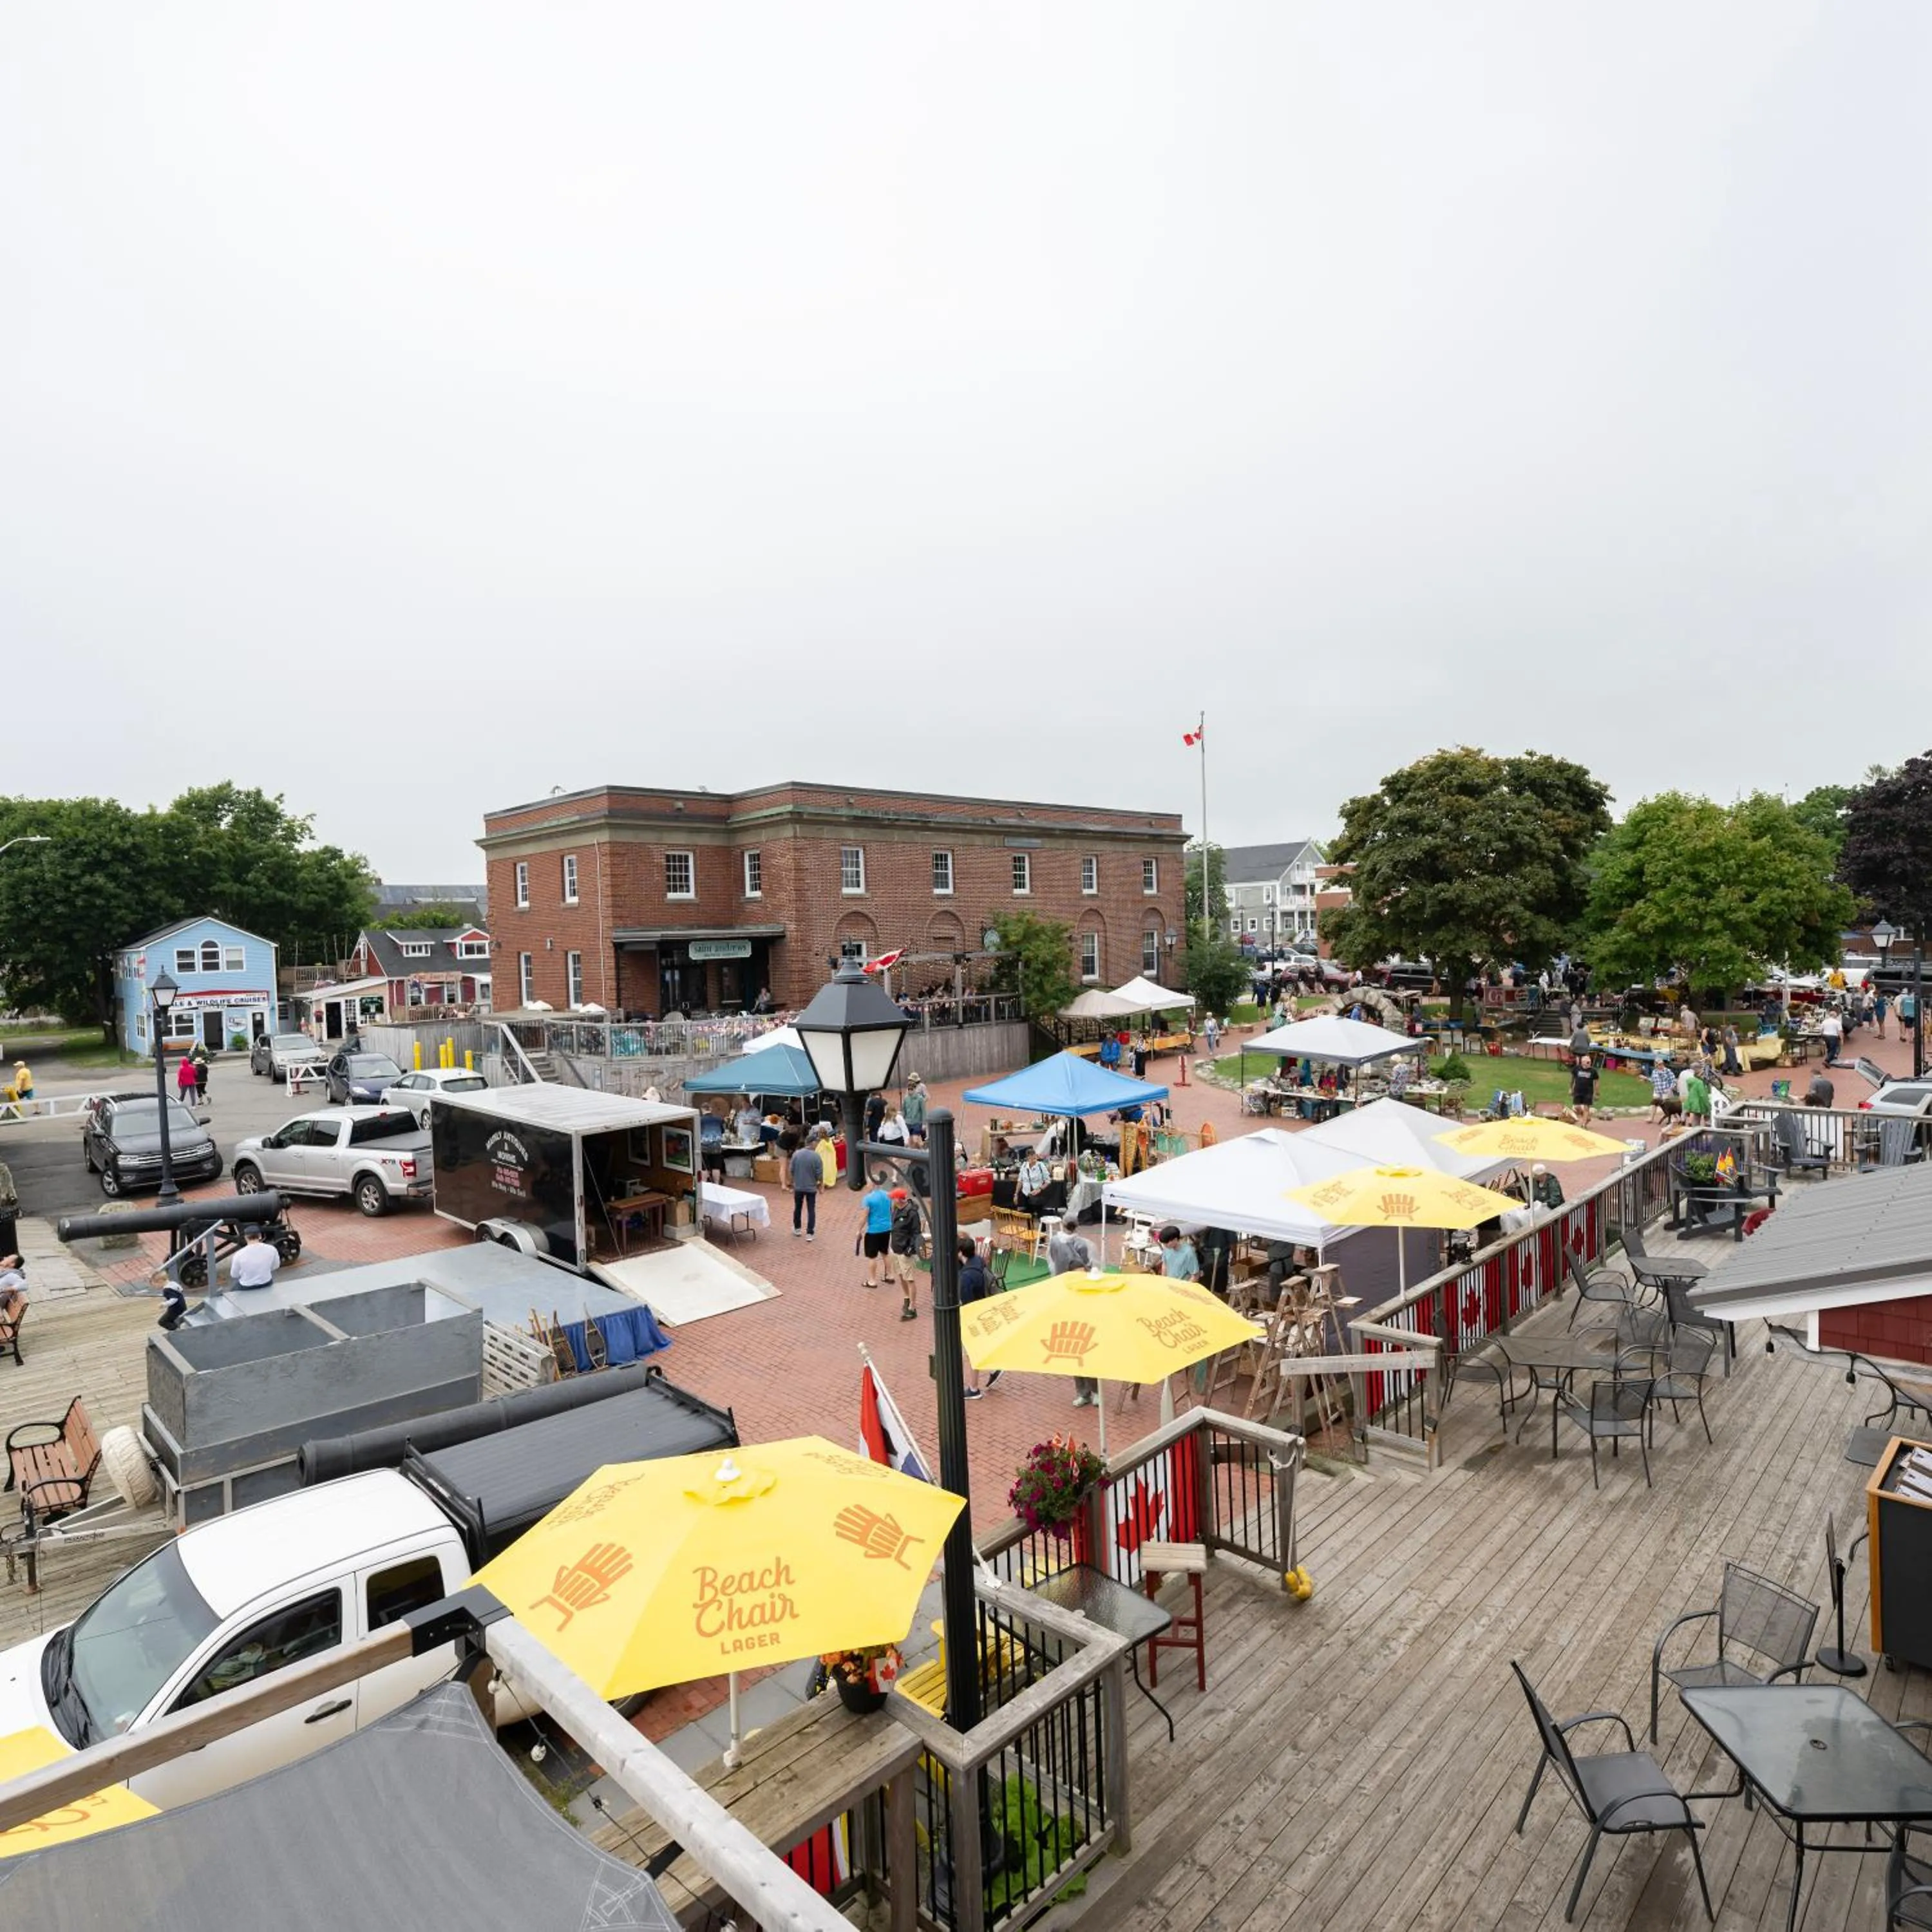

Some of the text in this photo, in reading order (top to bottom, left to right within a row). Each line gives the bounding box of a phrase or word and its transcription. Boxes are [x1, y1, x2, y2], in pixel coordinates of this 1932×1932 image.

[1136, 1307, 1191, 1333] Beach
[1152, 1321, 1208, 1349] Chair
[692, 1556, 795, 1602] Beach
[692, 1591, 800, 1638] Chair
[720, 1632, 781, 1655] LAGER
